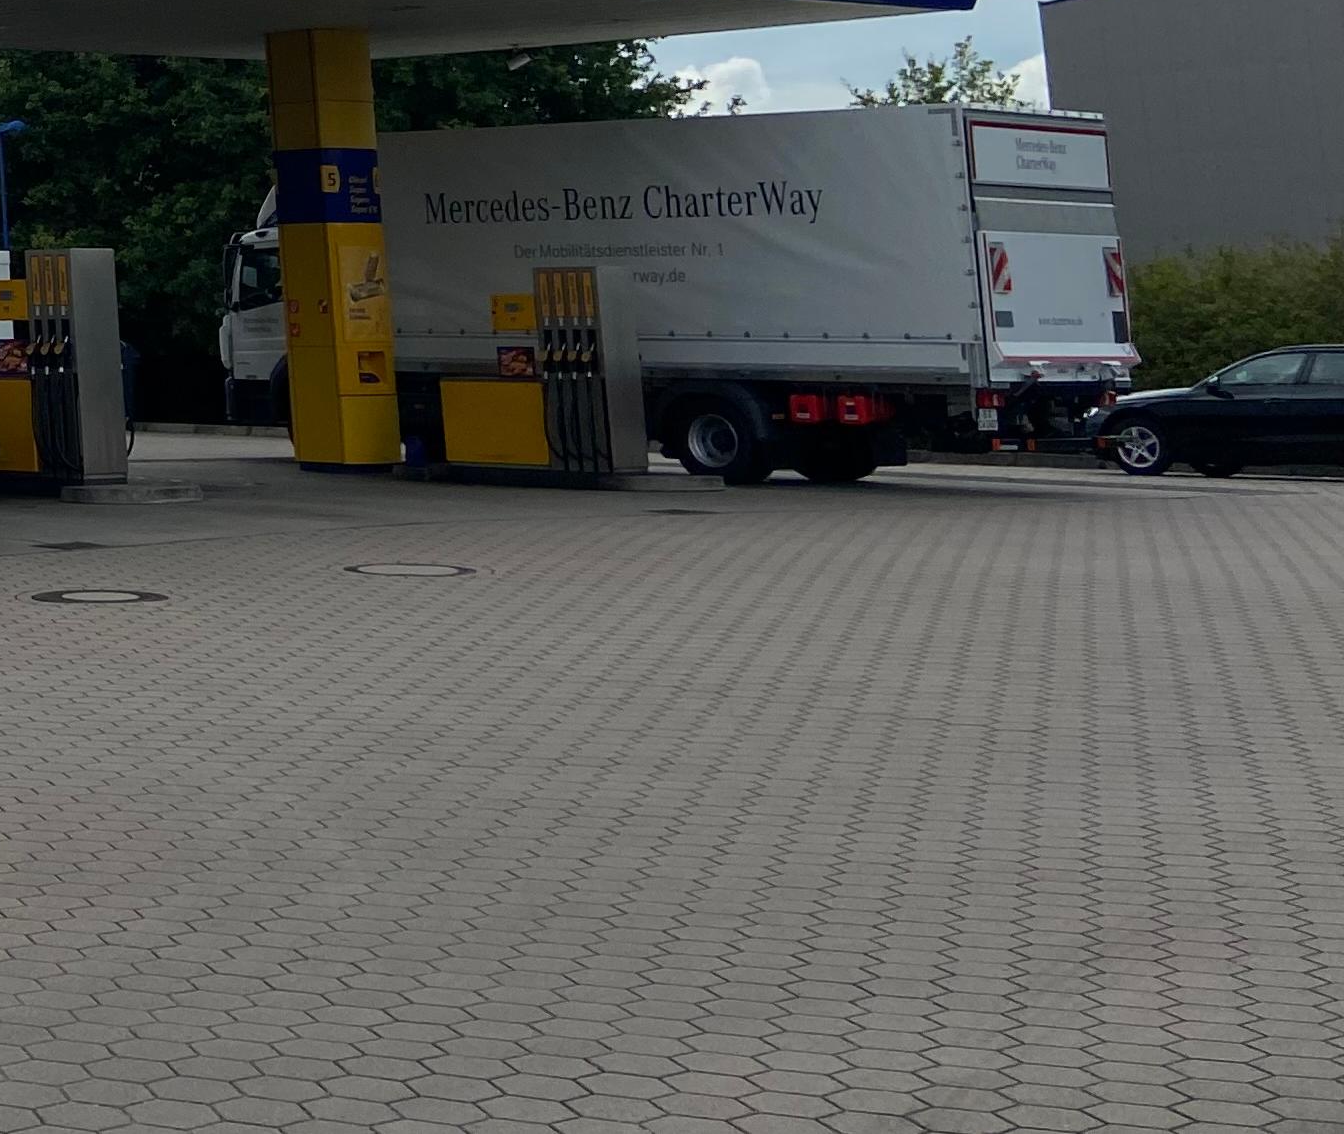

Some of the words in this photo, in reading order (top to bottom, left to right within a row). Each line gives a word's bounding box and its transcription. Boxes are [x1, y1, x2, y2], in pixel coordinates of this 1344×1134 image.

[327, 172, 337, 187] 5
[424, 188, 633, 224] Mercedes-Benz
[643, 180, 823, 224] CharterWay
[514, 244, 539, 259] Der
[540, 242, 687, 259] Mobilitätsdienstleister
[633, 267, 687, 286] rway.de
